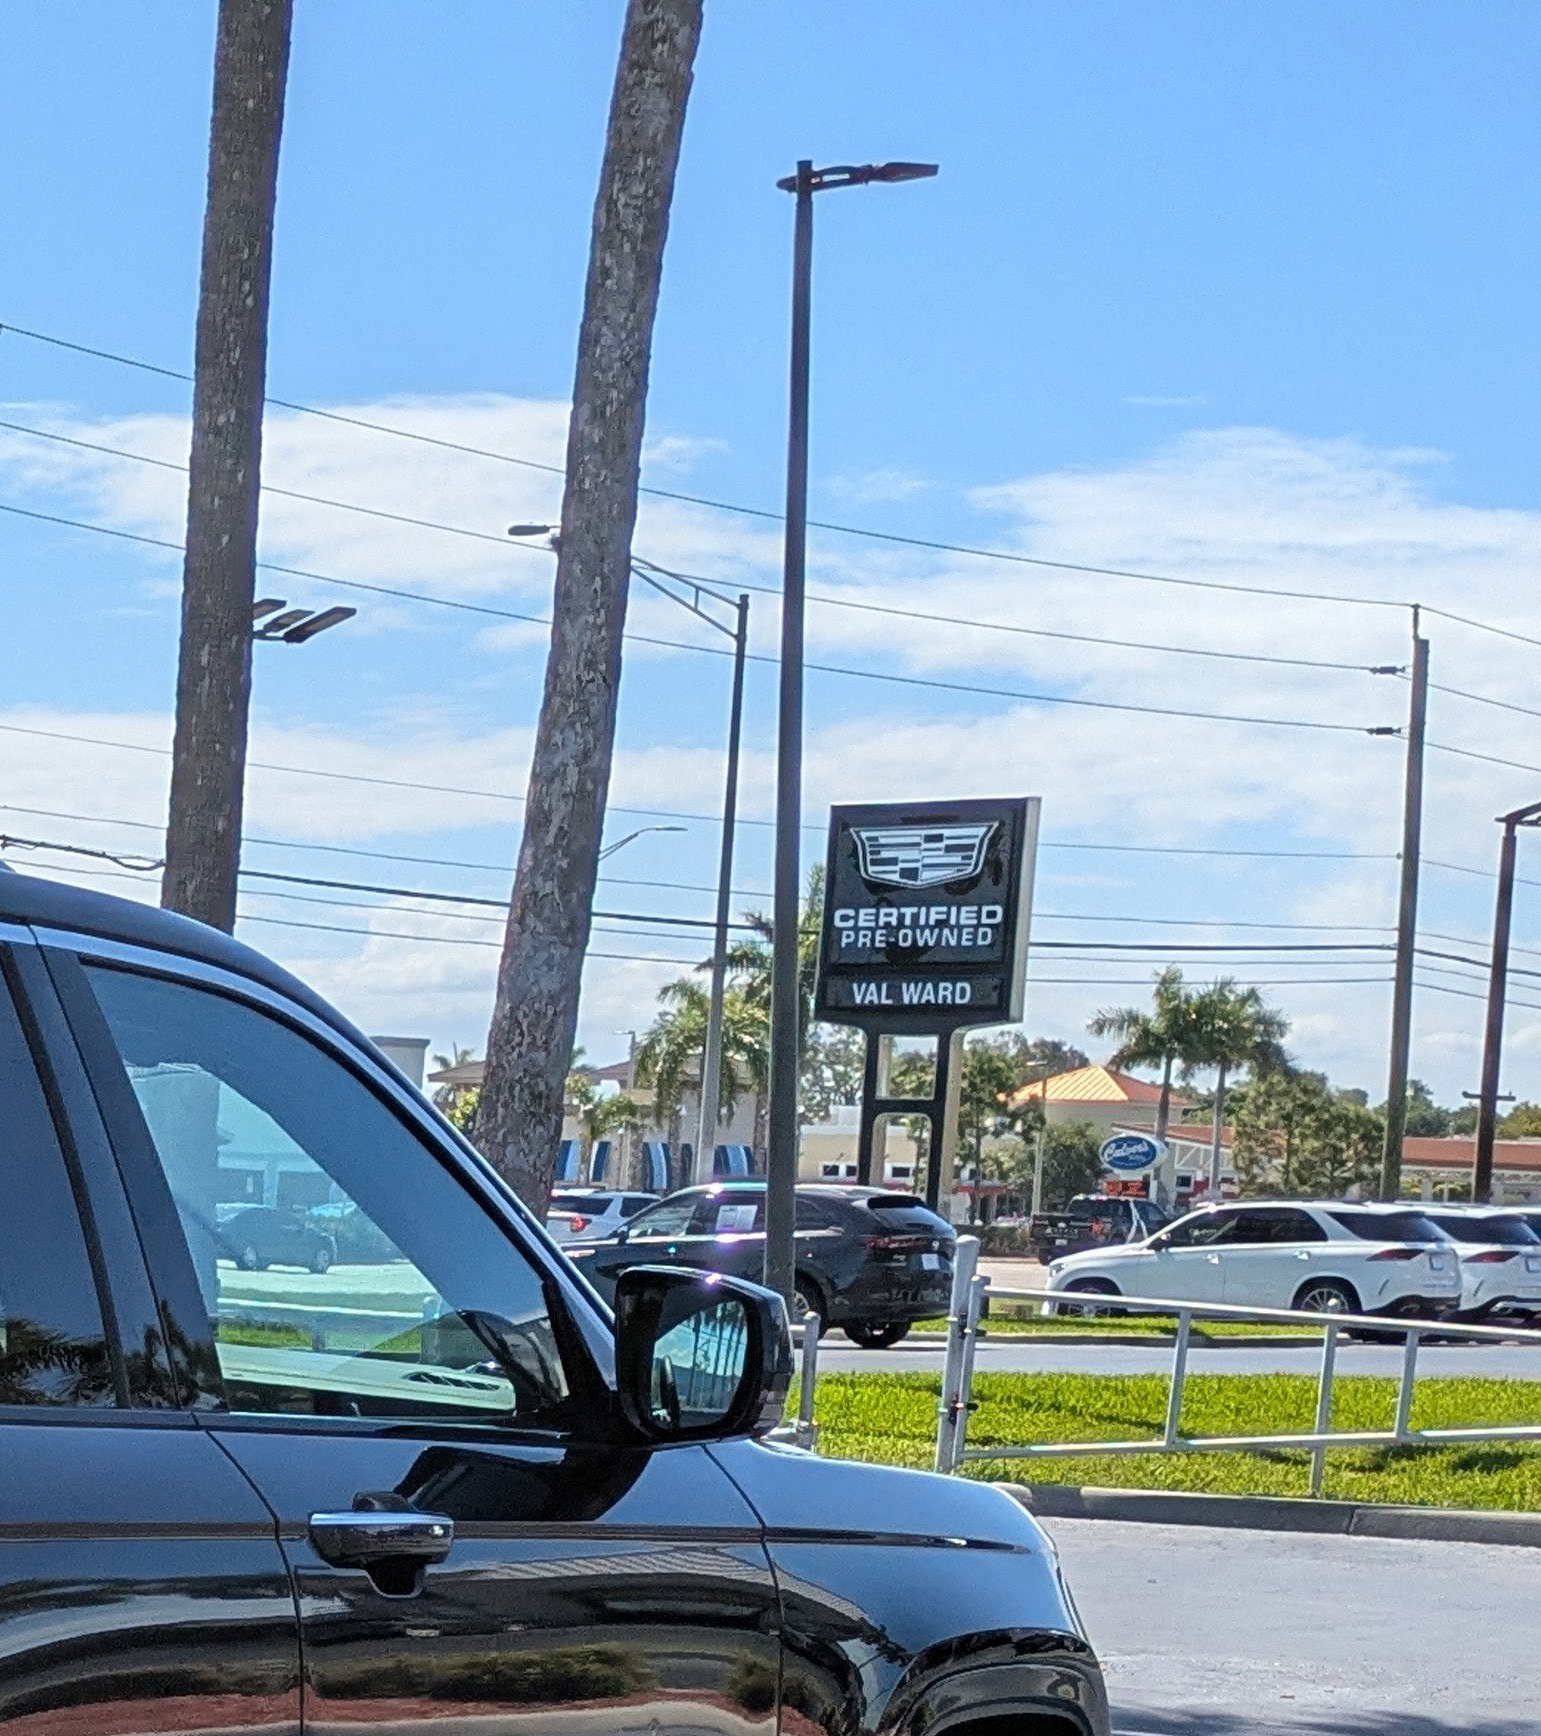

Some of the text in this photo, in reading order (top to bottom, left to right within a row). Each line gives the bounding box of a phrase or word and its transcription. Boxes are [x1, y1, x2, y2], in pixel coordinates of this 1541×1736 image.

[833, 904, 1004, 928] CERTIFIED
[841, 927, 993, 948] PRE-OWNED
[852, 982, 971, 1005] VAL WARD
